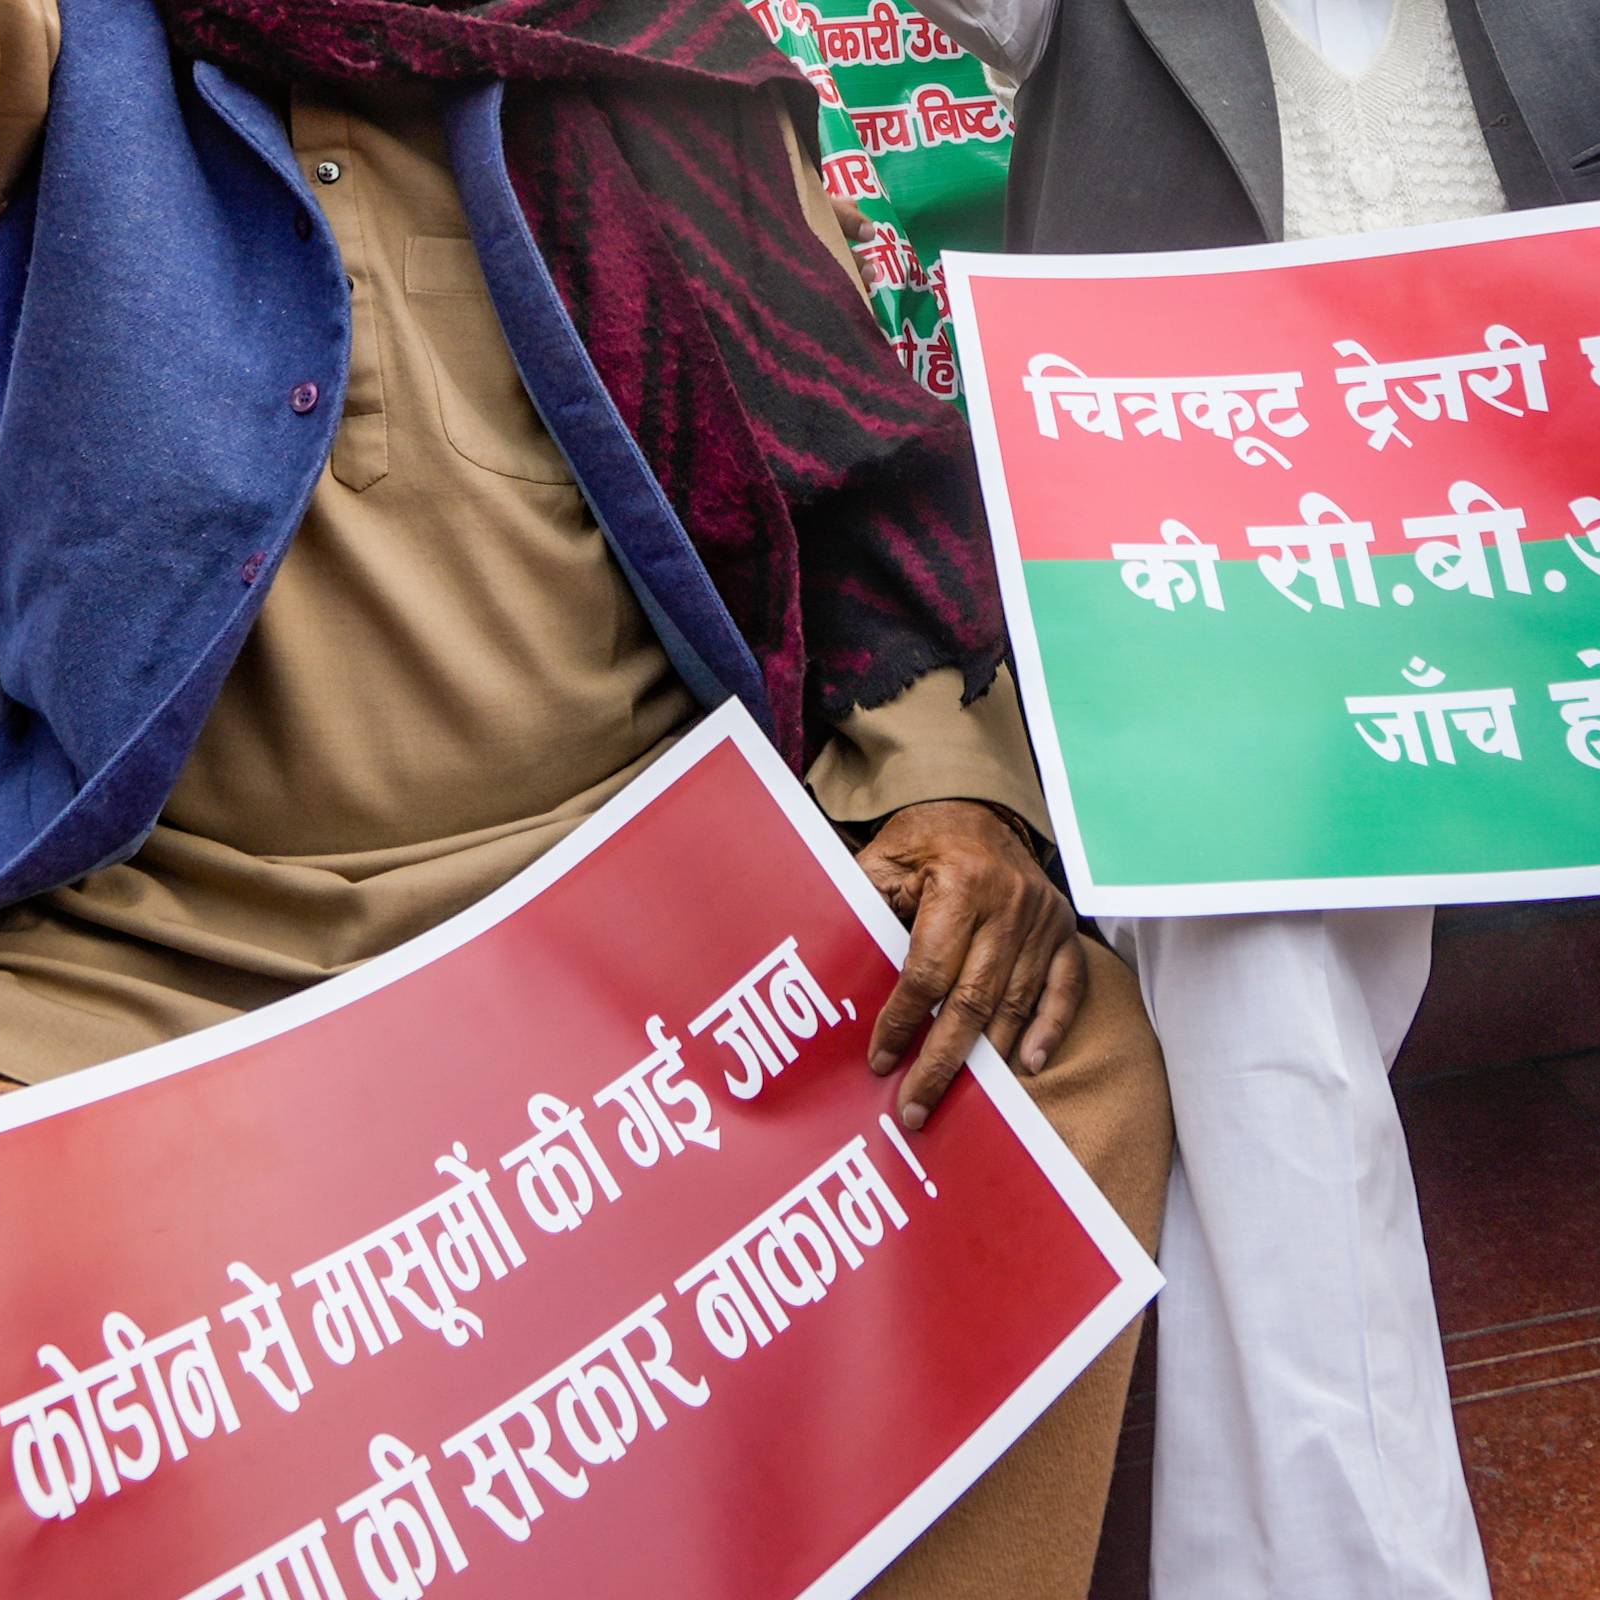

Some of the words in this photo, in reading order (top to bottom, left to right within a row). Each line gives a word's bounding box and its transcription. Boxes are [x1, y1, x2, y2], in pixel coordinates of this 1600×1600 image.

[1022, 353, 1309, 469] चित्रकूट
[1332, 325, 1548, 451] ट्रेजरी
[1110, 518, 1226, 613] की
[221, 1262, 313, 1412] से
[291, 1142, 526, 1363] मासूमों
[500, 1093, 622, 1232] की
[593, 1015, 720, 1167] गई
[688, 936, 856, 1099] जान,
[441, 1294, 710, 1541] सरकार
